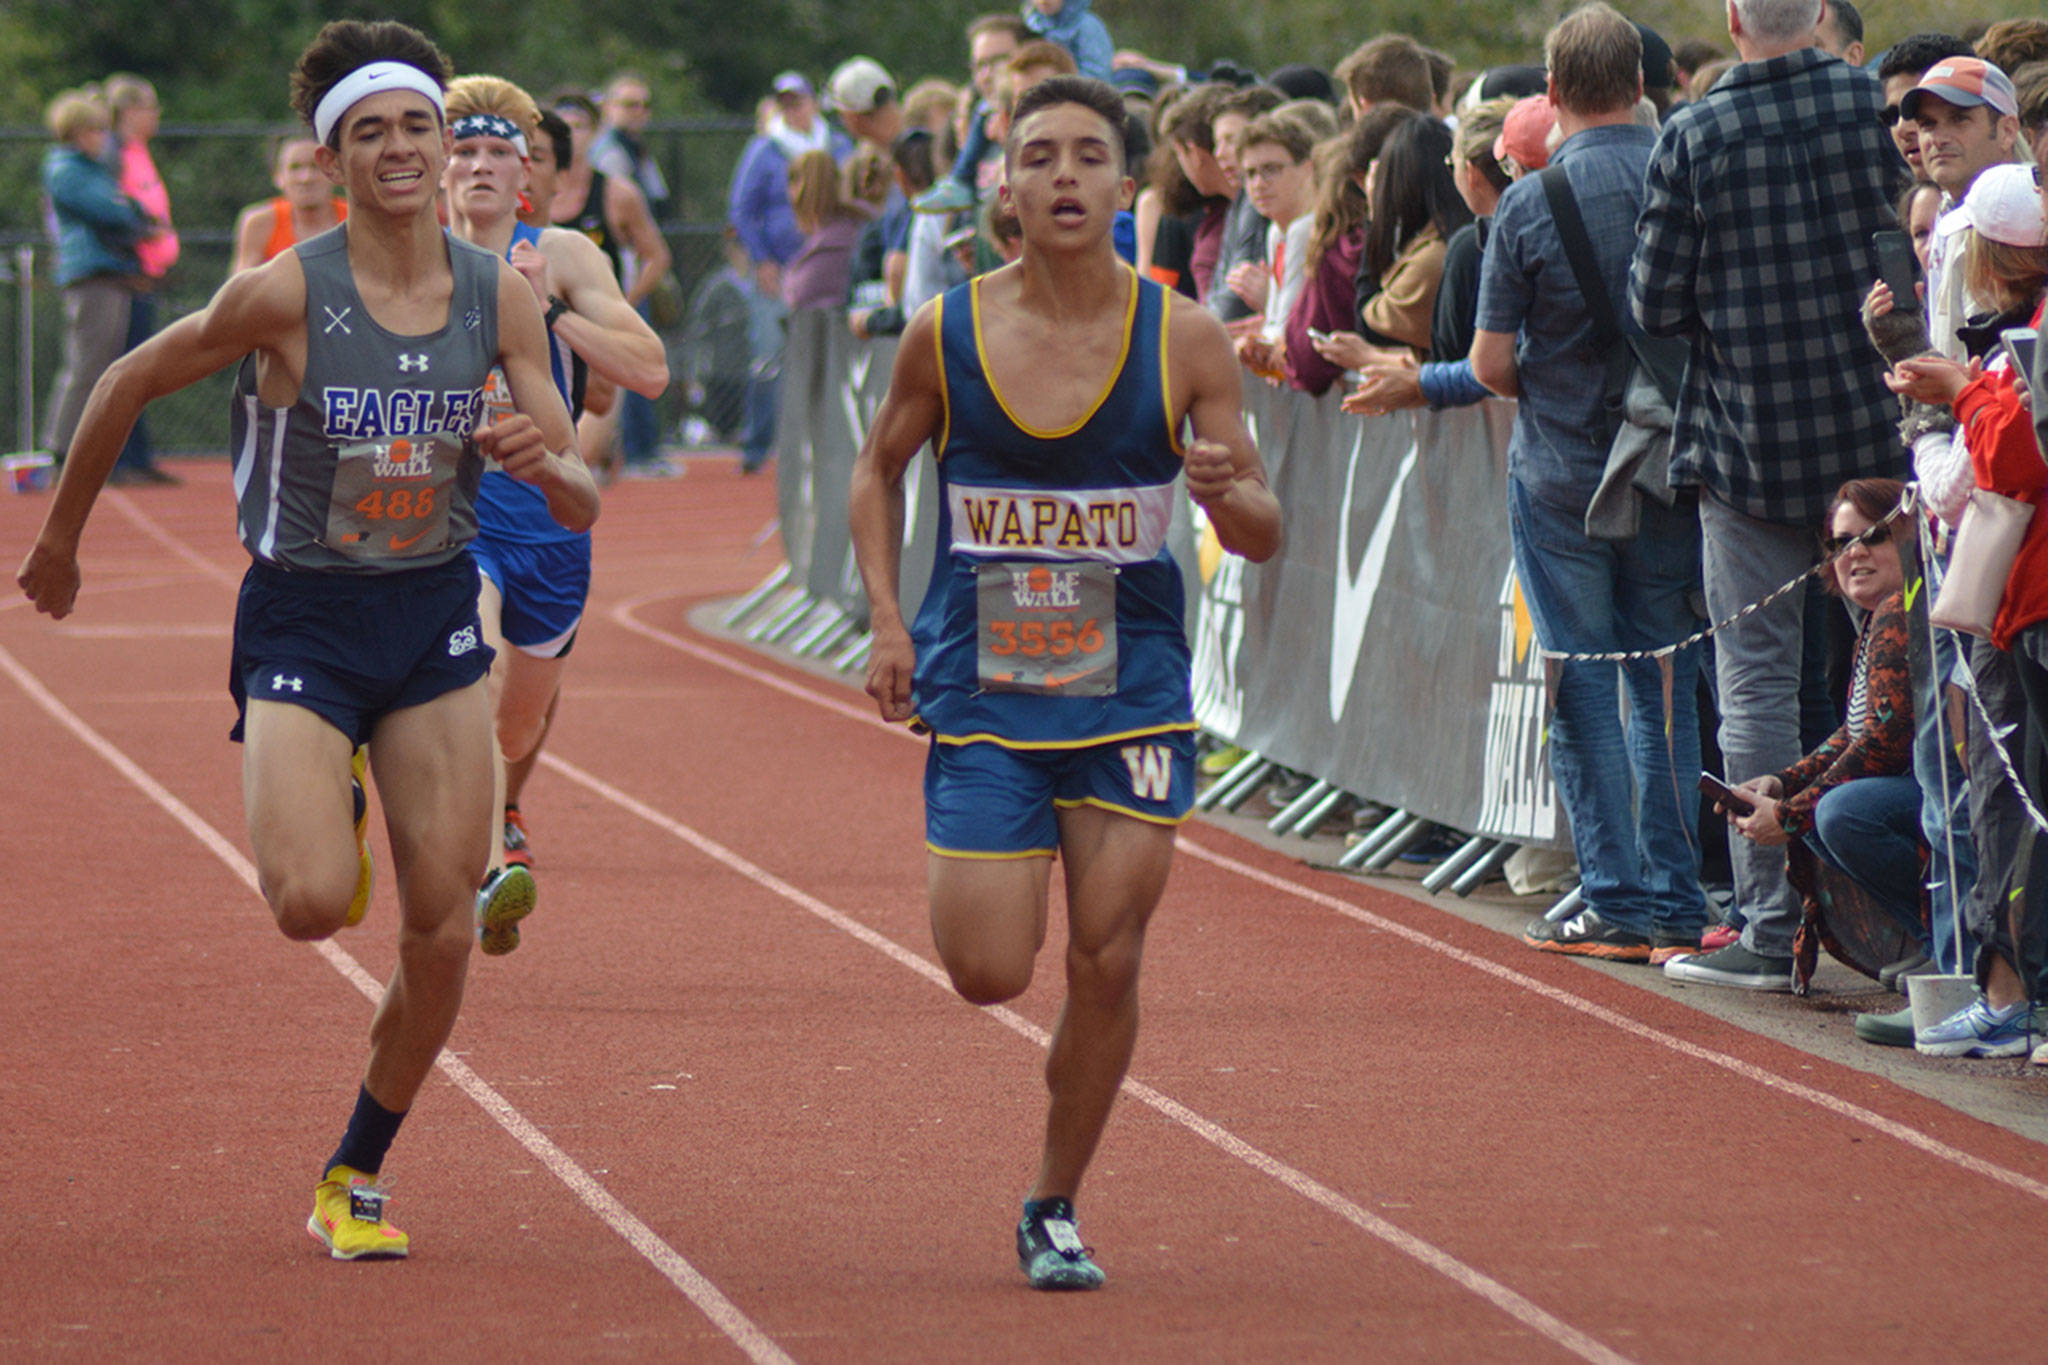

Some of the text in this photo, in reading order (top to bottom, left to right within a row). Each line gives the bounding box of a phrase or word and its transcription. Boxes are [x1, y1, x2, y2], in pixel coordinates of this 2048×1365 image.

[373, 461, 433, 477] WALL
[355, 487, 435, 520] 488
[963, 497, 1137, 547] WAPATO
[1012, 590, 1080, 607] WALL
[989, 620, 1105, 657] 3556
[1121, 745, 1172, 801] W
[1563, 916, 1586, 937] N
